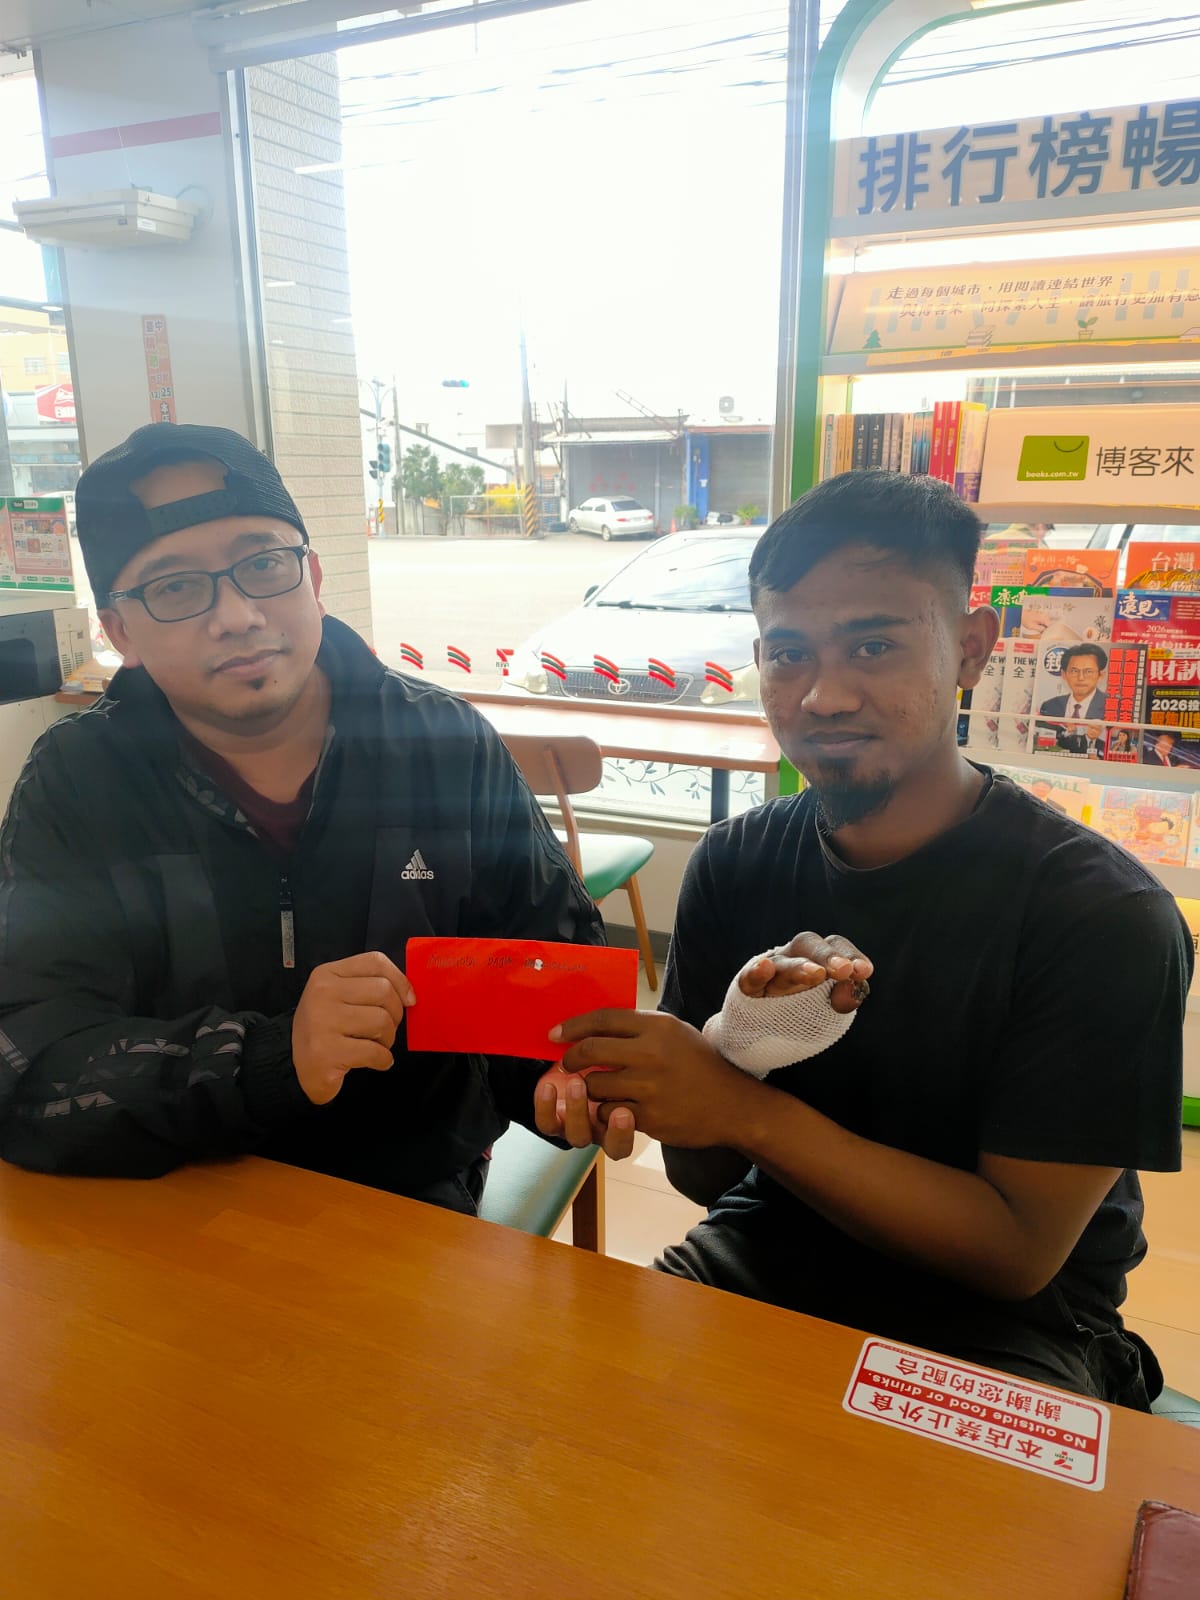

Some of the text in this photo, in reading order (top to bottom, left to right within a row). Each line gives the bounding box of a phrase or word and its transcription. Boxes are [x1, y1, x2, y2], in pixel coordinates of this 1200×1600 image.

[1096, 446, 1195, 476] 博客來
[1014, 657, 1026, 665] THE
[401, 868, 434, 880] adidas
[868, 1373, 1087, 1449] No outside food or drinks.
[896, 1358, 1061, 1422] 謝謝您的配合
[869, 1392, 1043, 1459] 本店禁止外食
